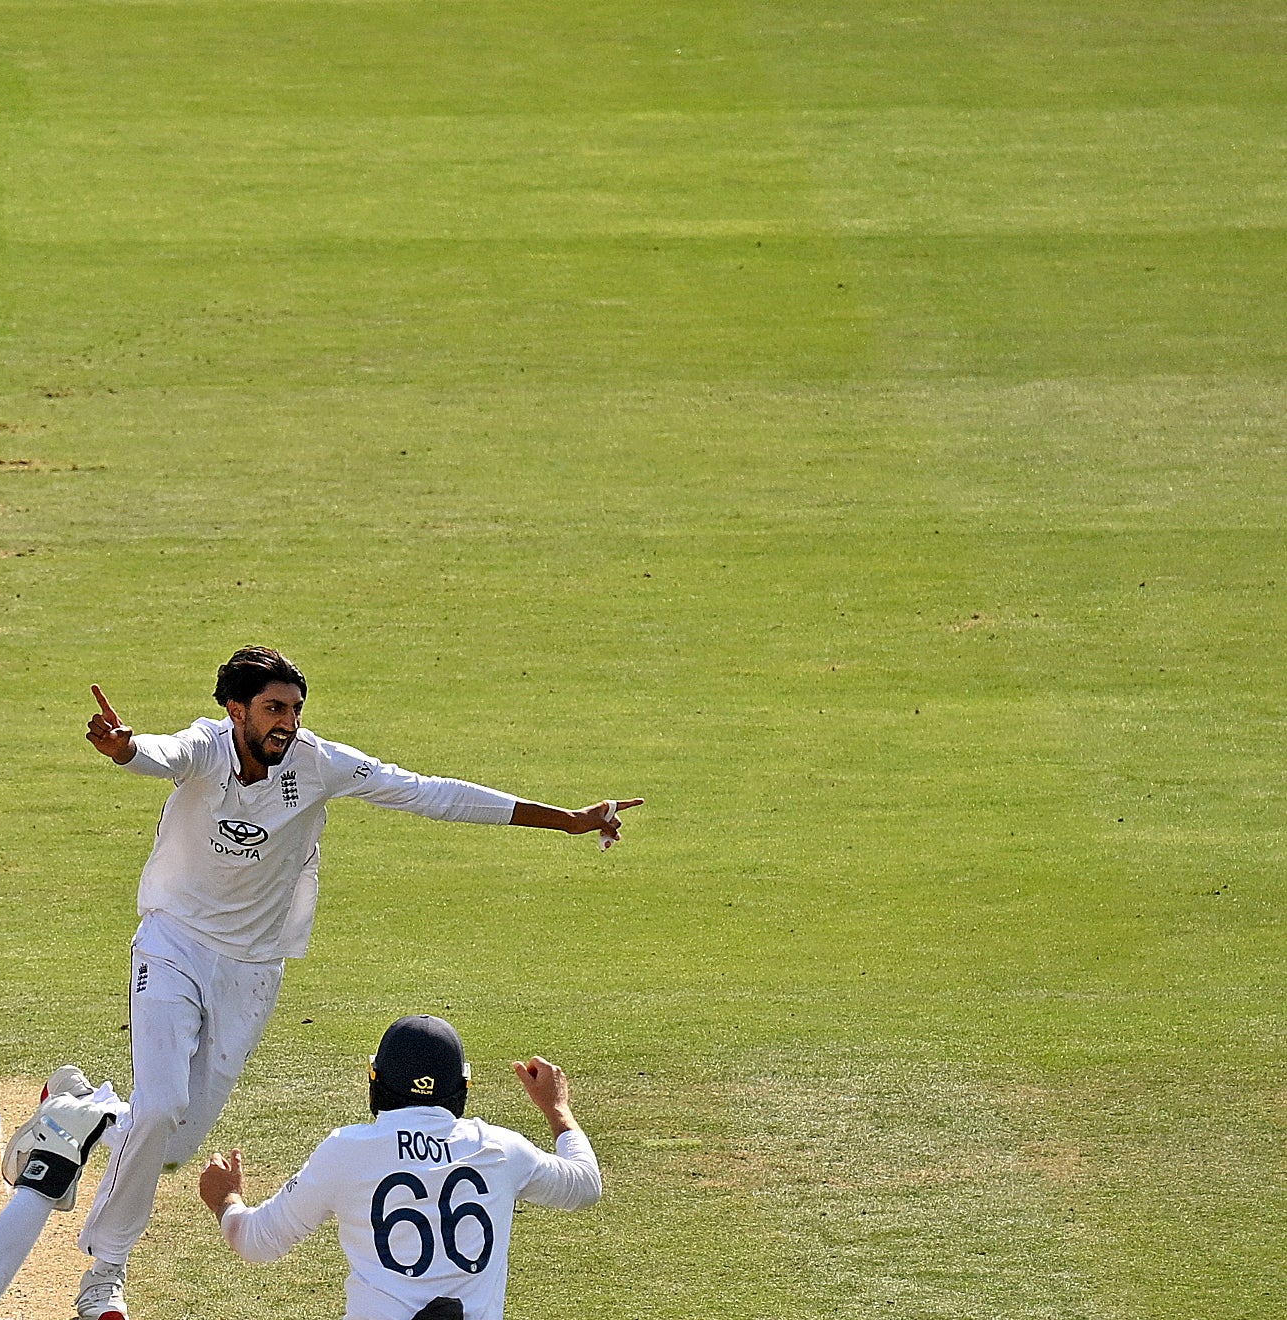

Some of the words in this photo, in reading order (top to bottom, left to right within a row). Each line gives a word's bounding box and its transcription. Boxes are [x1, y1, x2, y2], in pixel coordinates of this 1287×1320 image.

[209, 836, 261, 861] TOYOTA
[397, 1130, 452, 1163] ROOT
[370, 1166, 495, 1279] 66
